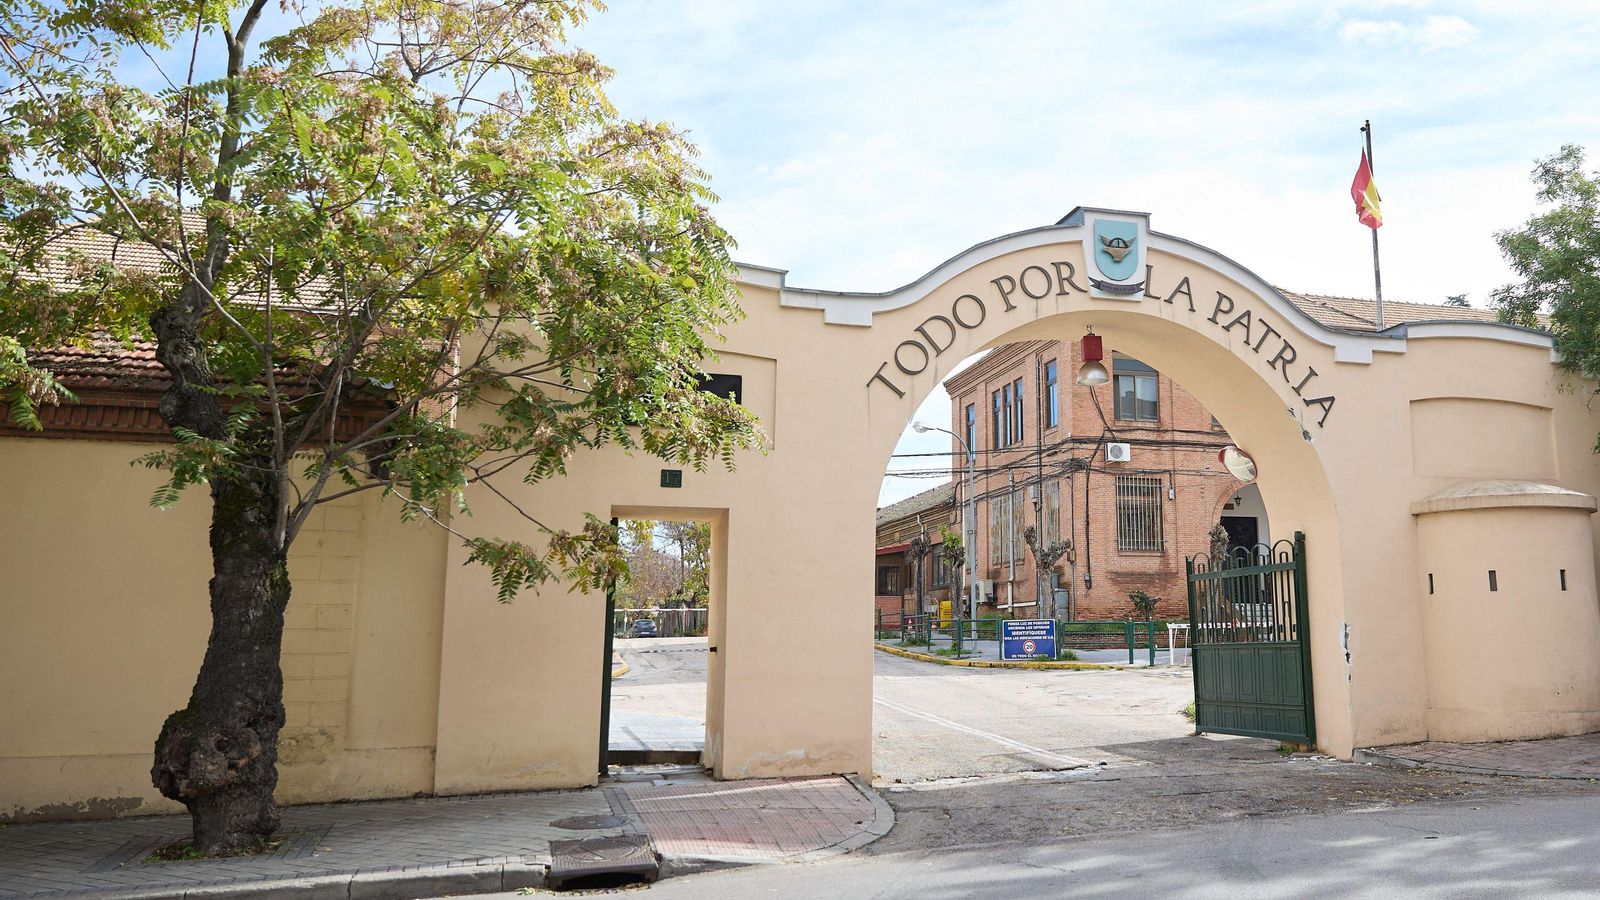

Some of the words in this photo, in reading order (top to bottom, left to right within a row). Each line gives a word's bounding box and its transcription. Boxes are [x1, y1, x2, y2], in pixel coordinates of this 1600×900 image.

[866, 294, 986, 399] TODO
[990, 261, 1088, 312] POR
[1143, 264, 1196, 312] LA
[1207, 291, 1336, 428] PATRIA
